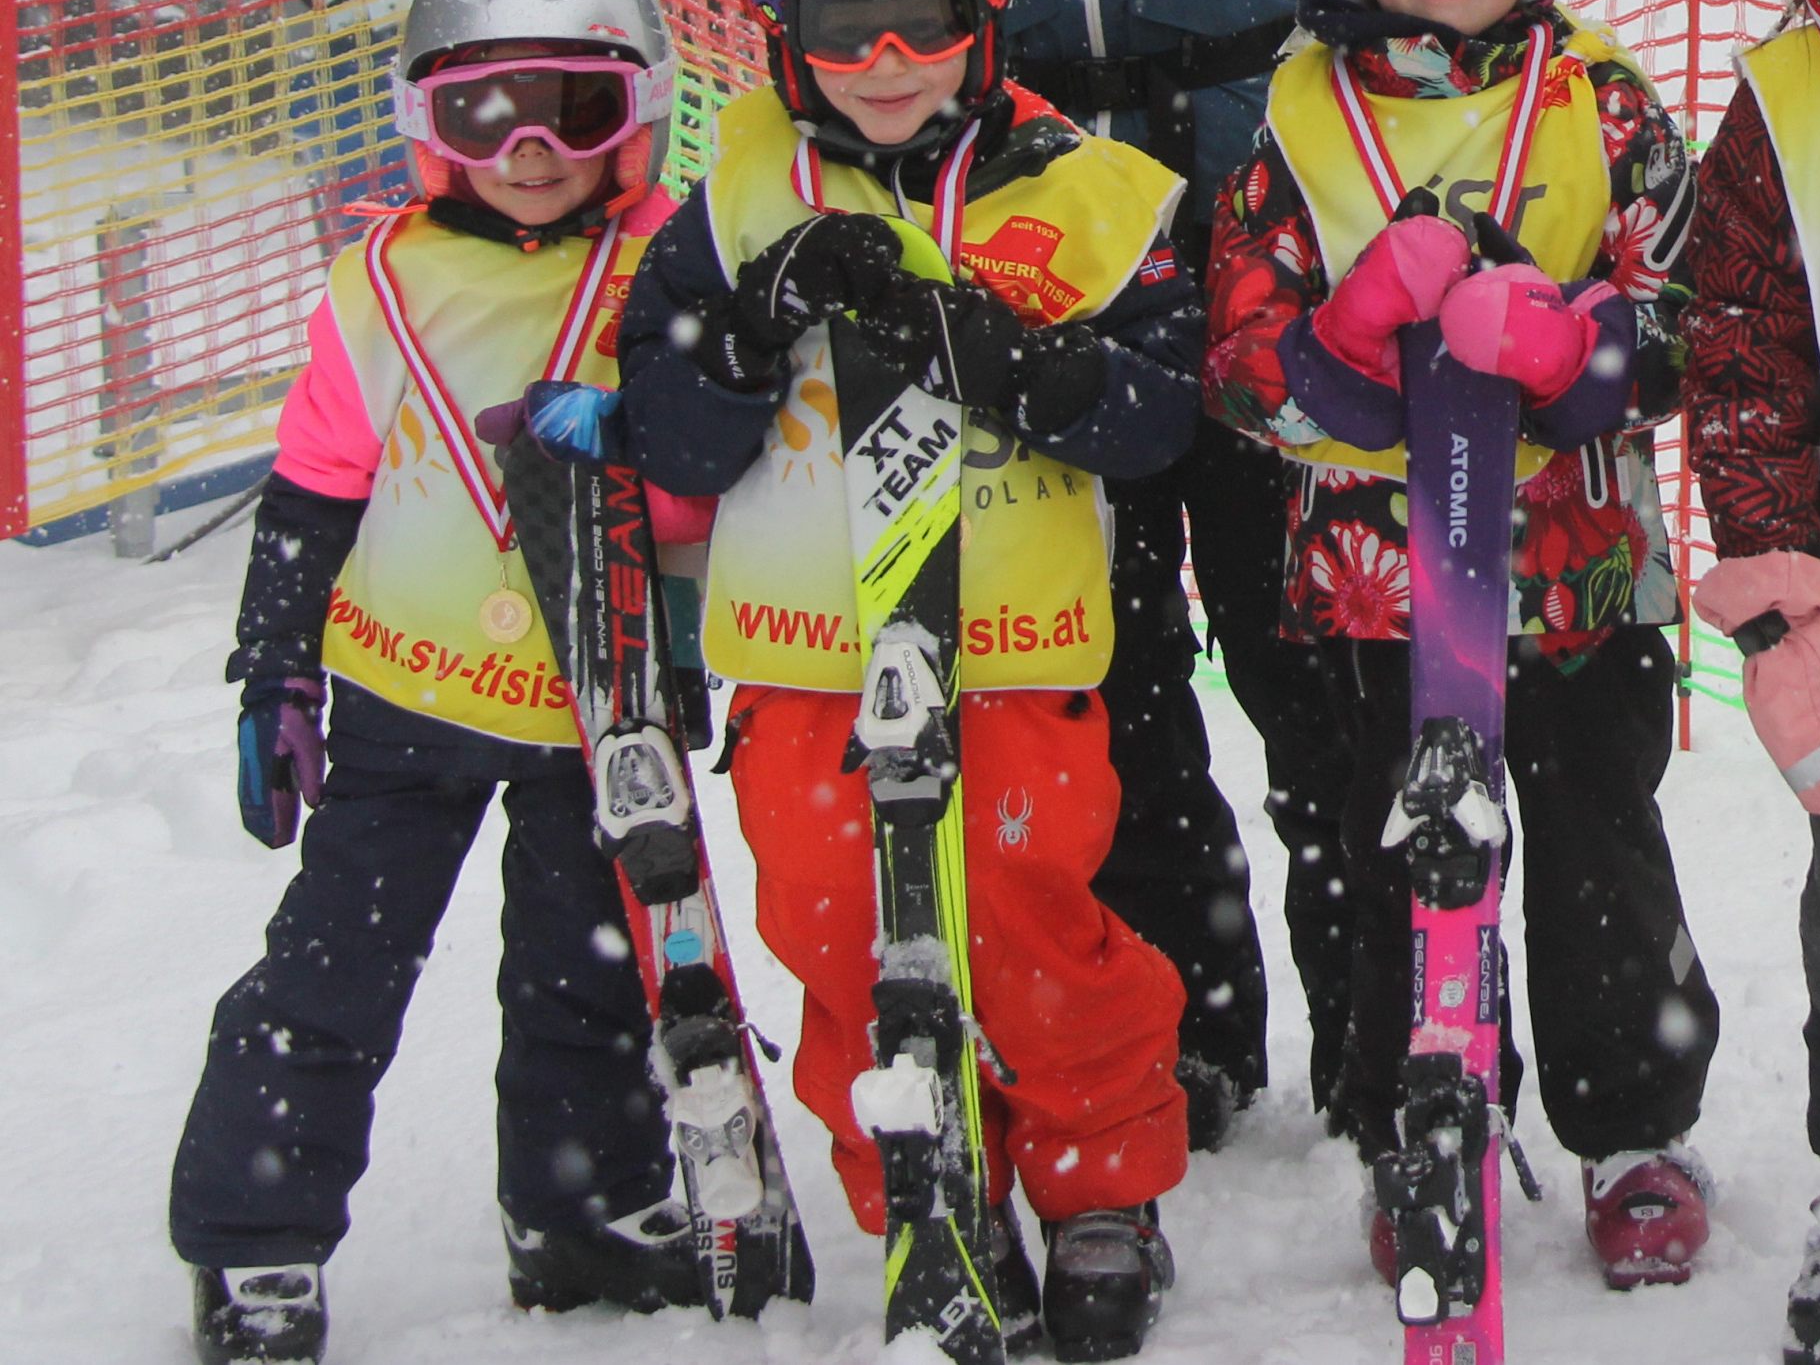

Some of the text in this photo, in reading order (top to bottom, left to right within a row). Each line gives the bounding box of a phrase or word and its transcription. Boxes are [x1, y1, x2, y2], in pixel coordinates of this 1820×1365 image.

[1010, 220, 1034, 232] seit
[856, 405, 913, 474] XT
[863, 418, 959, 517] TEAM
[592, 475, 601, 519] TECH
[975, 473, 1078, 510] OLAR
[1448, 432, 1468, 549] ATOMIC
[593, 524, 605, 573] CORE
[605, 464, 650, 664] TEAM
